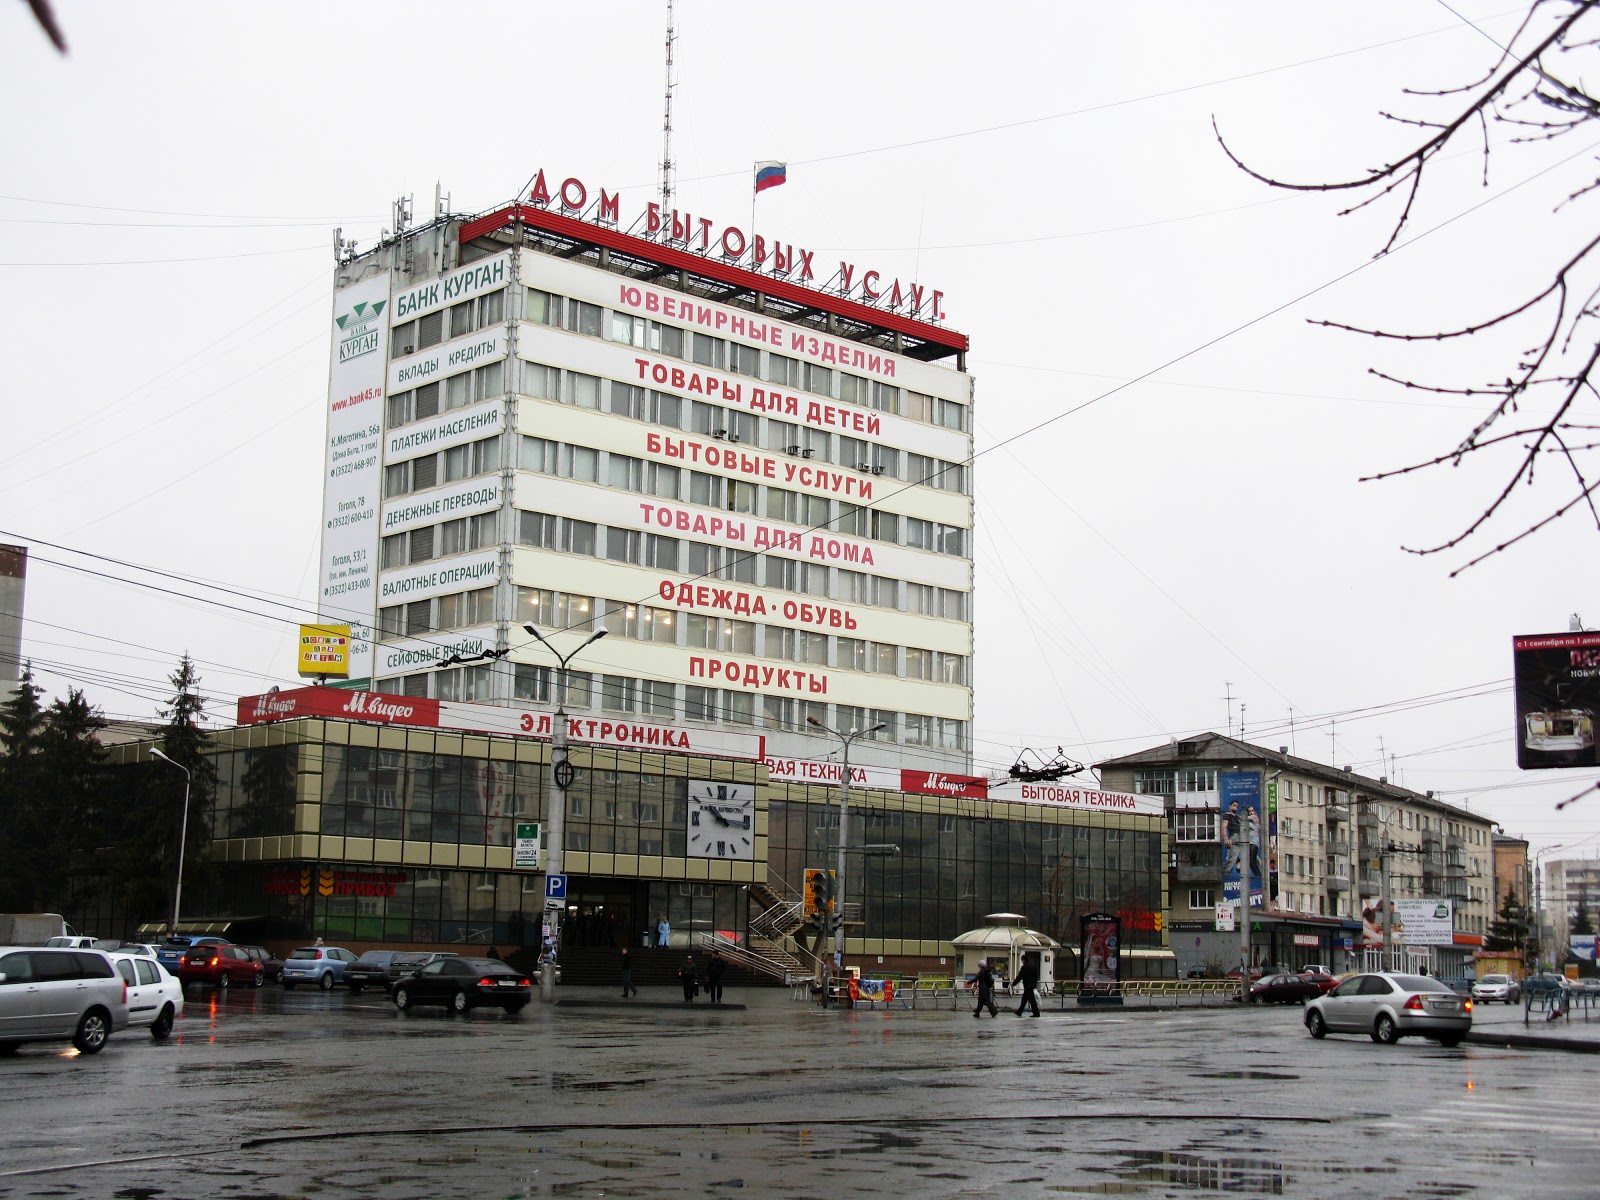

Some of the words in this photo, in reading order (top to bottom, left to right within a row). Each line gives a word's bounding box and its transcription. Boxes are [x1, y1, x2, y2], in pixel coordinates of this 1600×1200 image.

[529, 168, 620, 223] ДОМ
[646, 202, 815, 281] БЫТОВЫХ
[397, 281, 439, 318] БАНК
[443, 258, 505, 303] КУРГАН
[350, 324, 368, 337] БАНК
[619, 284, 784, 347] ЮВЕЛИРНЫЕ
[790, 332, 896, 377] ИЗДЕЛИЯ
[339, 331, 379, 361] КУРГАН
[398, 358, 439, 383] ВКЛАДЫ
[448, 338, 497, 367] КРЕДИТЫ
[331, 387, 382, 413] www.bank45.ru
[634, 358, 742, 402] ТОВАРЫ
[750, 387, 799, 417] ДЛЯ
[806, 401, 881, 436] ДЕТЕЙ
[368, 423, 380, 437] 56а
[391, 426, 437, 453] ПЛАТЕЖИ
[438, 408, 498, 438] НАСЕЛЕНИЯ
[335, 462, 354, 478] (3522)
[353, 456, 377, 471] 468-907
[646, 432, 777, 479] БЫТОВЫЕ
[784, 462, 873, 500] УСЛУГИ
[332, 514, 351, 529] (3522)
[350, 509, 374, 523] 600-410
[338, 500, 357, 512] Гоголя,
[357, 496, 365, 507] 78
[385, 500, 440, 529] ДЕНЕЖНЫЕ
[442, 486, 498, 512] ПЕРЕВОДЫ
[639, 503, 746, 542] ТОВАРЫ
[753, 526, 801, 550] ДЛЯ
[809, 536, 875, 566] ДОМА
[332, 554, 352, 567] Гоголя,
[352, 548, 367, 562] 53/1
[329, 583, 347, 597] (3522)
[347, 578, 371, 592] 433-000
[382, 572, 437, 597] ВАЛЮТНЫЕ
[439, 560, 495, 585] ОПЕРАЦИИ
[659, 580, 767, 616] ОДЕЖДА
[783, 600, 858, 630] ОБУВЬ
[362, 627, 370, 638] 60
[1529, 638, 1564, 648] сентября
[1582, 637, 1600, 645] дека
[386, 644, 441, 668] СЕЙФОВЫЕ
[442, 638, 483, 661] ЯЧЕЙКИ
[689, 656, 828, 695] ПРОДУКТЫ
[342, 691, 414, 721] М.видео
[520, 713, 691, 749] ЭЛКТРОНИКА
[1021, 784, 1080, 804] БЫТОВАЯ
[1083, 790, 1136, 809] ТЕХНИКА
[334, 882, 396, 897] ПРИВОЗ
[549, 877, 562, 895] P
